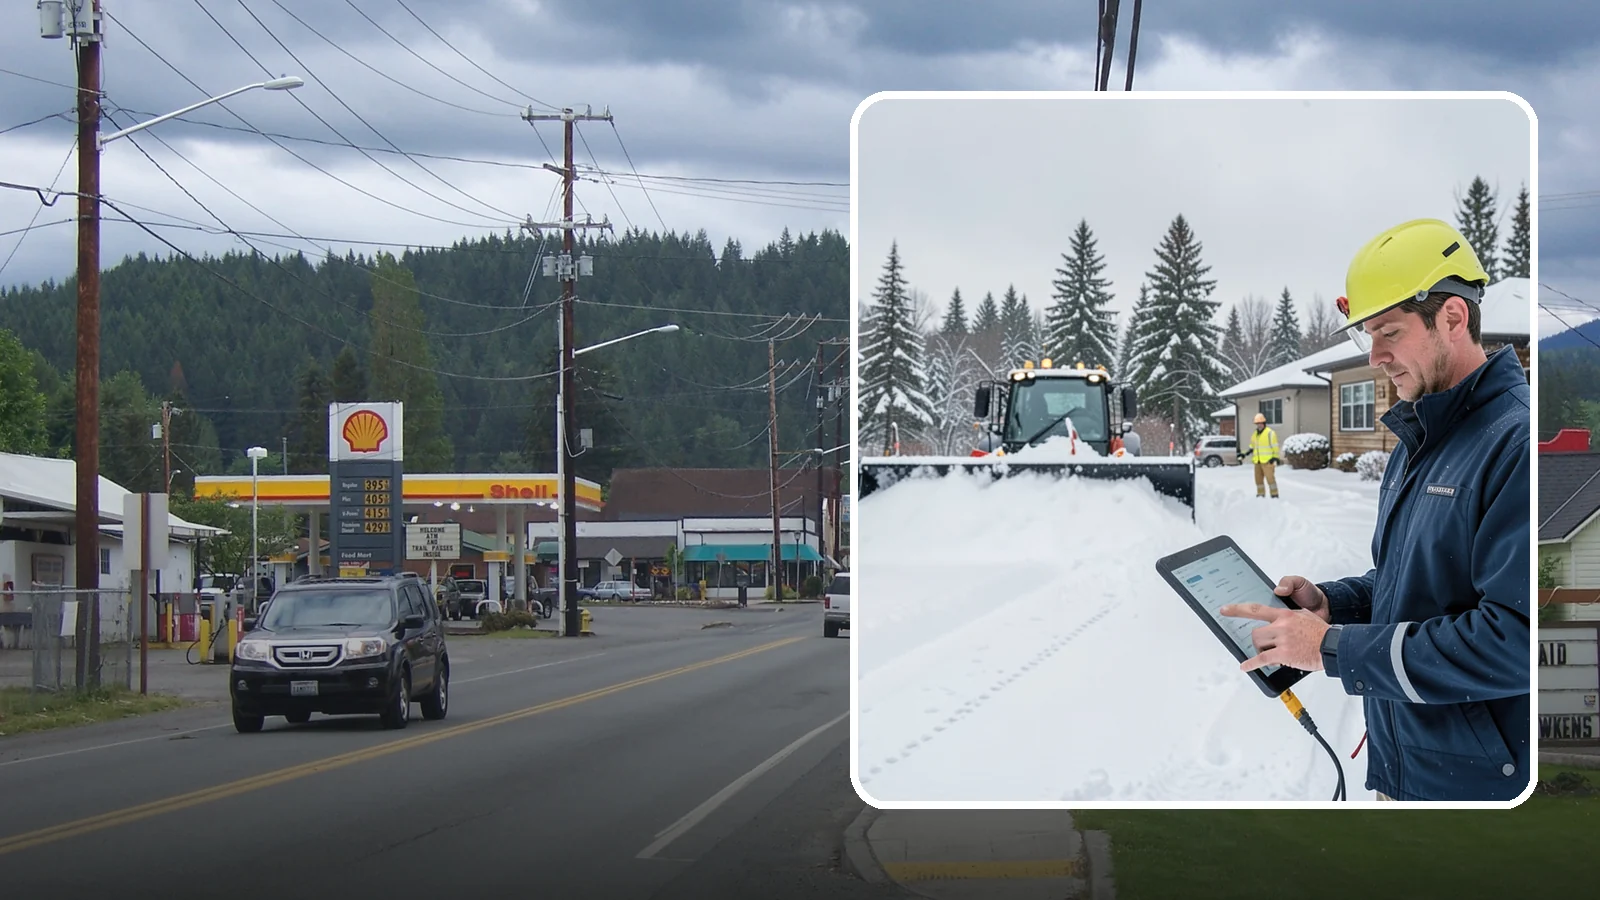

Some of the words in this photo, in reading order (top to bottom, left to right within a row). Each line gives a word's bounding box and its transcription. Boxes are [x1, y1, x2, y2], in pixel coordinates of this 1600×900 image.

[365, 480, 384, 490] 395
[490, 484, 547, 499] Shell
[365, 494, 384, 504] 405
[365, 508, 384, 518] 415
[365, 522, 384, 533] 429
